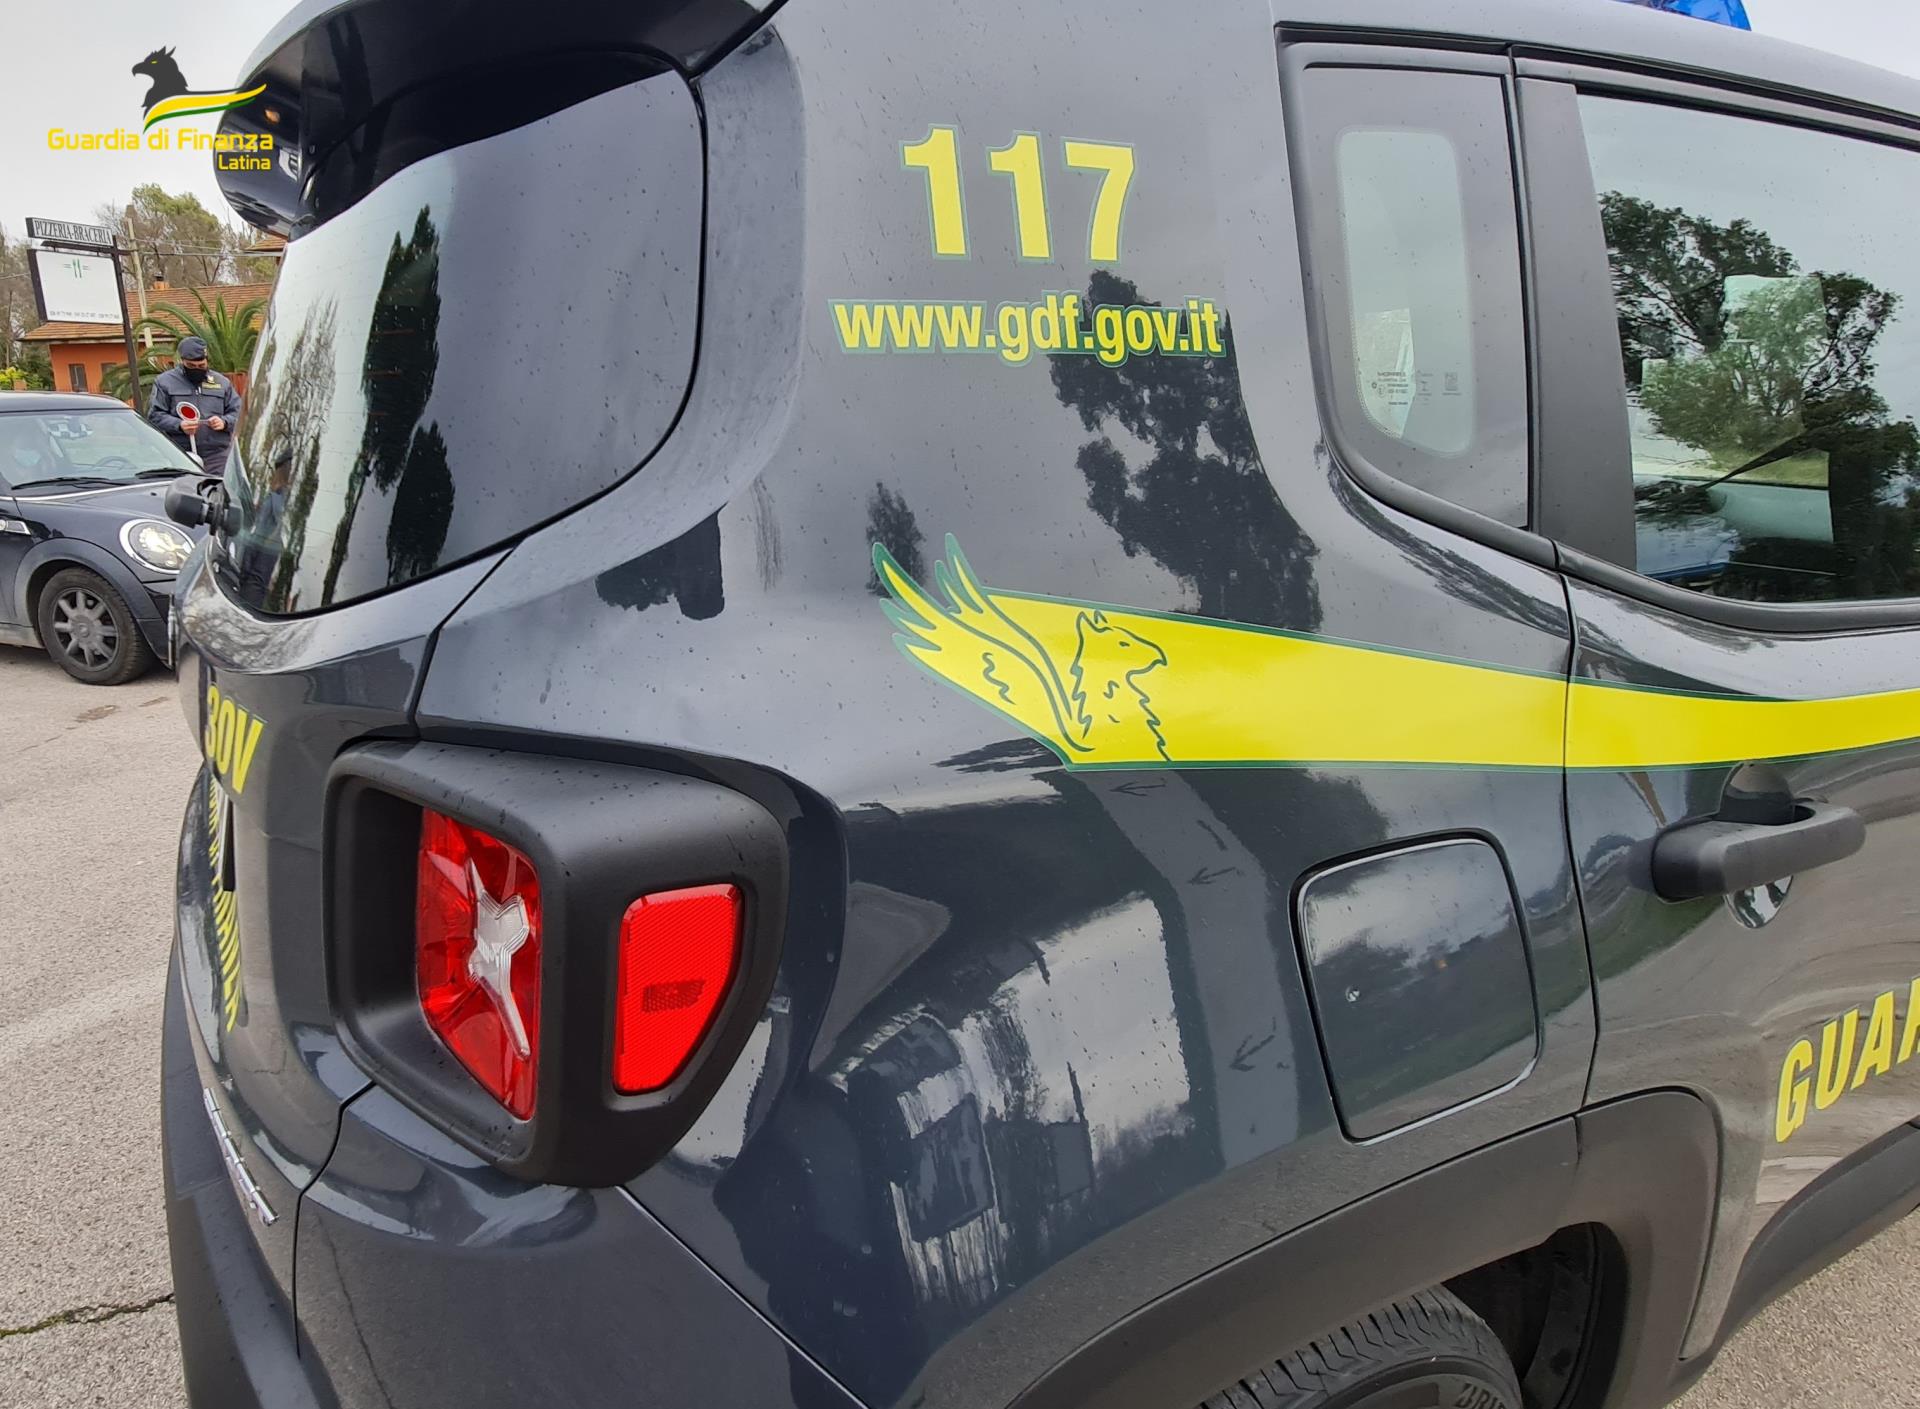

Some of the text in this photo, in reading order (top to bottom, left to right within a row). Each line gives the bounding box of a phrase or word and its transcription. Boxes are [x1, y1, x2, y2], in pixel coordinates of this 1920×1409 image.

[902, 124, 1136, 262] 117
[34, 220, 113, 245] PIZZERIA-BRACERIA
[830, 292, 1225, 365] www.gdf.gov.it
